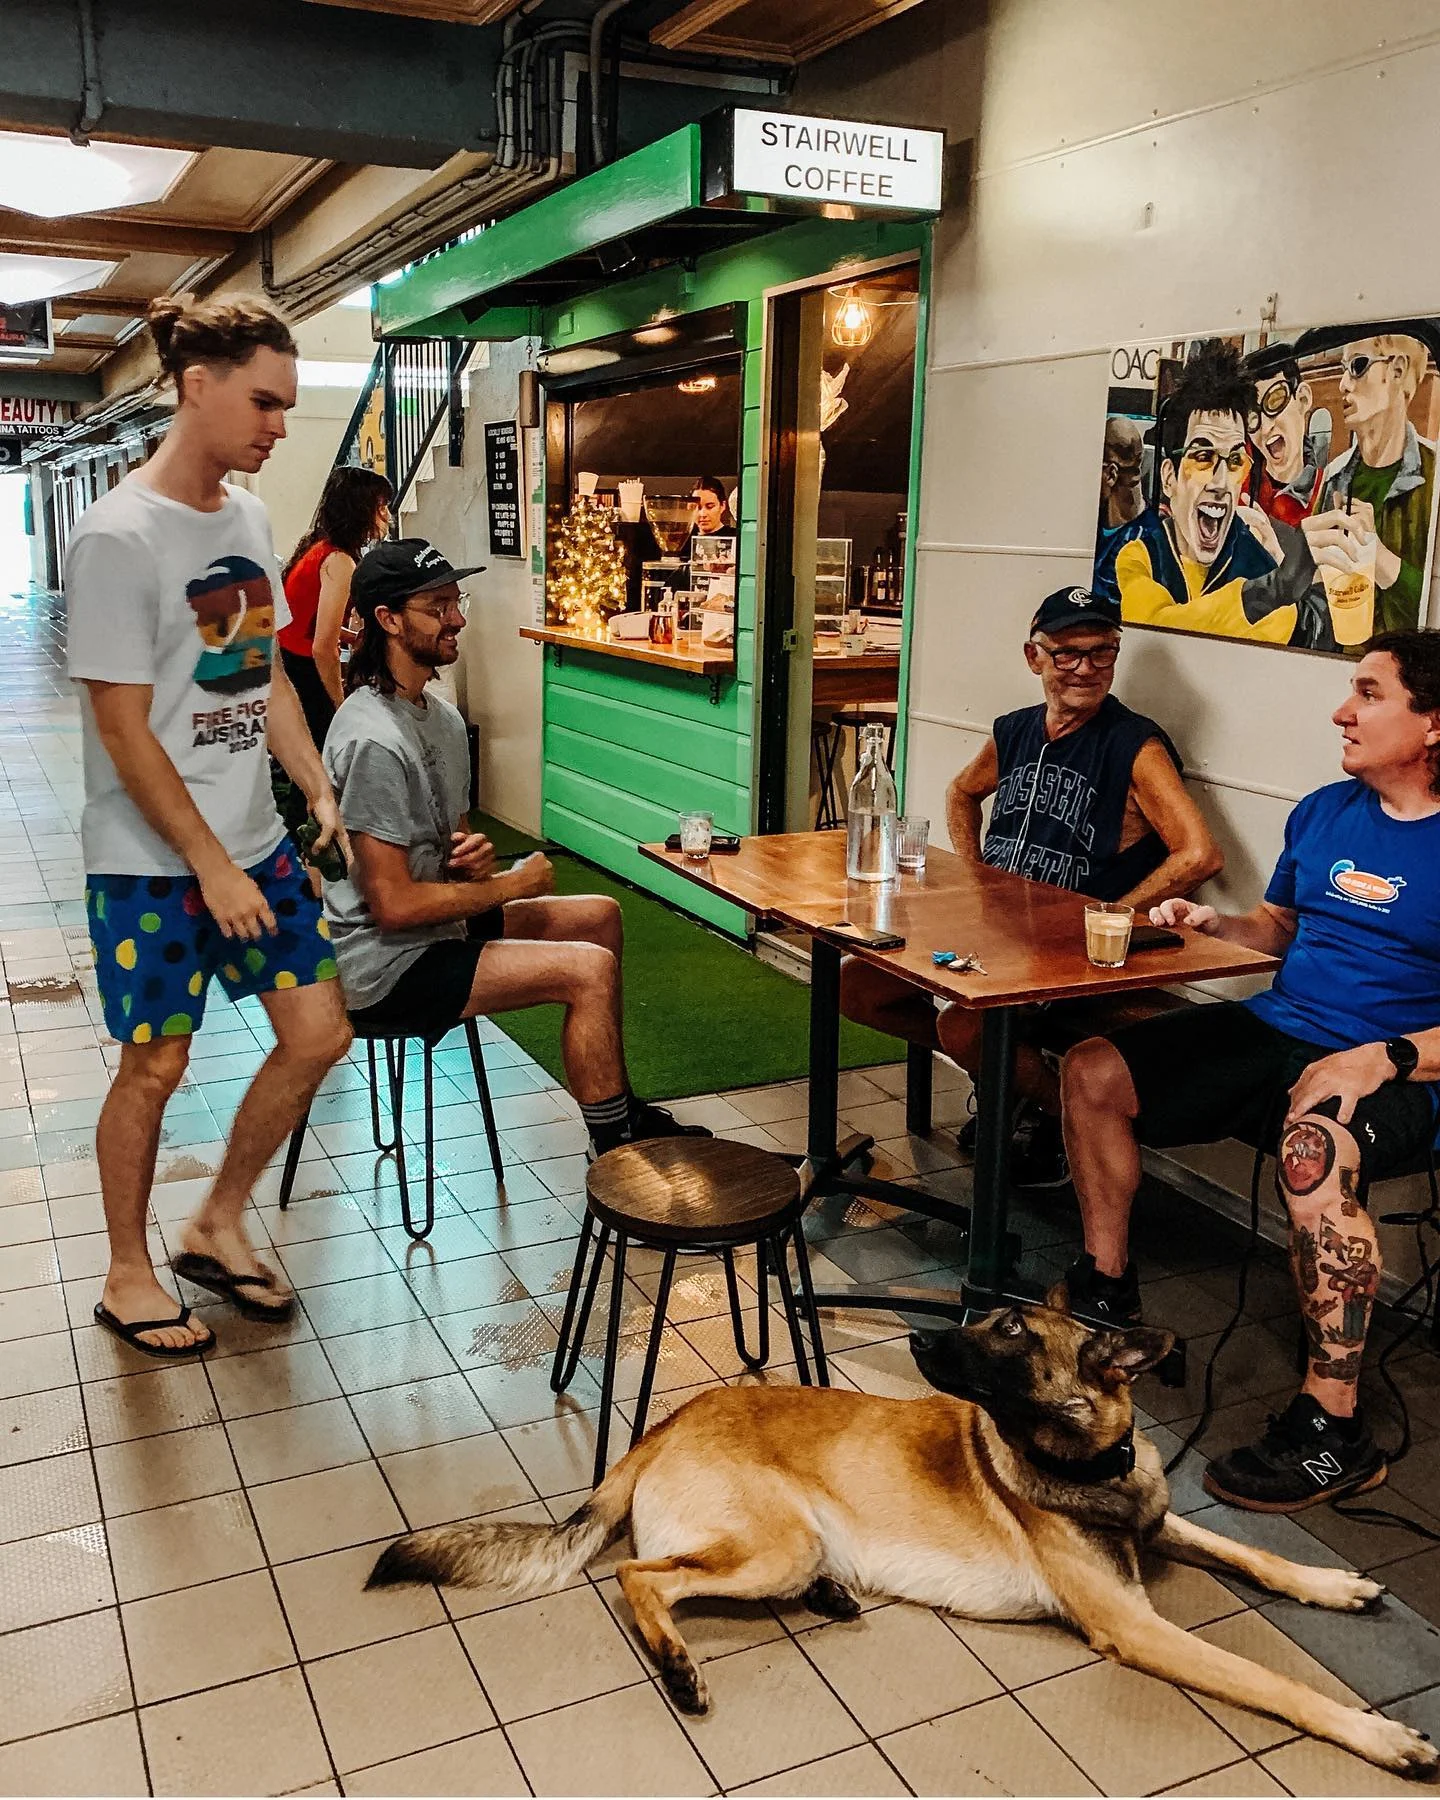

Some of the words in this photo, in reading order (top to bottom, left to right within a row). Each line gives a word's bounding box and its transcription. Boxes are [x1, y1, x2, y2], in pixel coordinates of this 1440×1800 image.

[761, 121, 917, 163] STAIRWELL
[784, 164, 893, 198] COFFEE
[1111, 347, 1162, 380] OAC
[1, 397, 58, 423] EAUTY
[0, 425, 15, 434] NA
[17, 425, 59, 435] TATTOOS
[192, 706, 233, 730] FIRE
[237, 698, 269, 718] FIG
[1302, 1451, 1343, 1486] N
